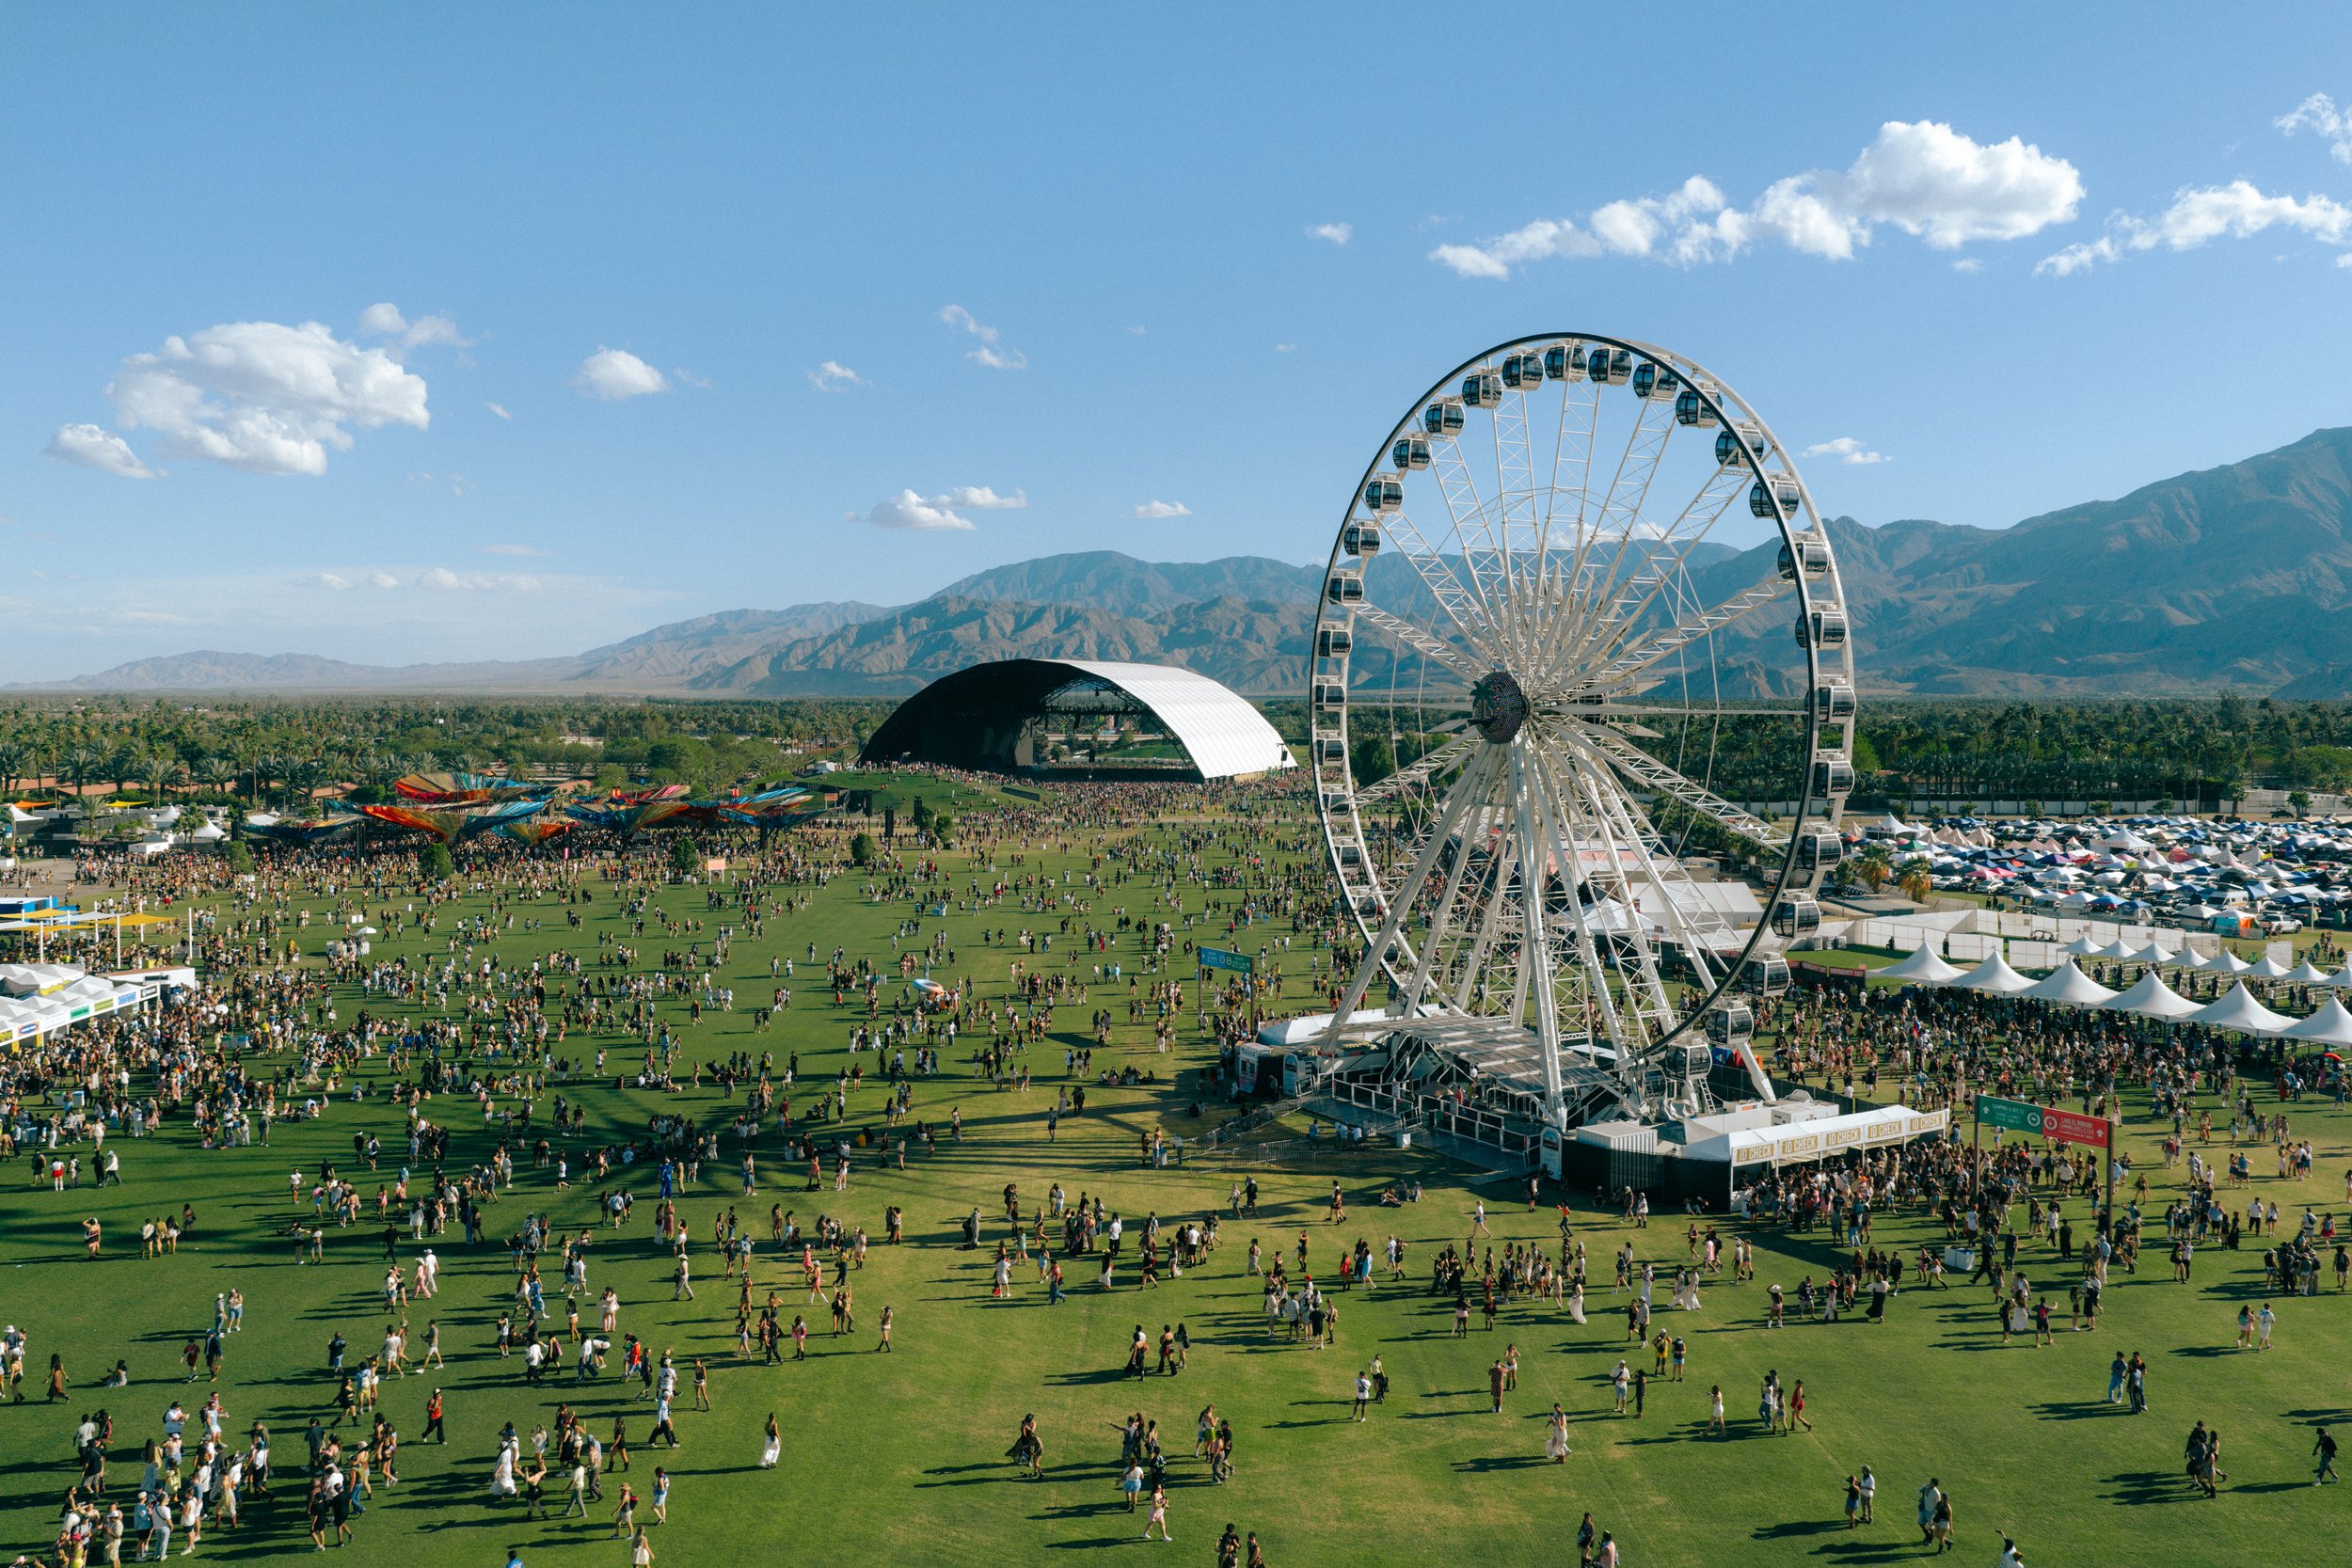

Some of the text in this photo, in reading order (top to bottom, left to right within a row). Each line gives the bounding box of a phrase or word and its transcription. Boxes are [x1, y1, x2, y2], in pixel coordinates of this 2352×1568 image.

[1870, 1121, 1899, 1137] ID CHECK
[1912, 1115, 1941, 1131] ID CHECK
[1785, 1136, 1816, 1153] ID CHECK
[1829, 1129, 1859, 1146] ID CHECK
[1740, 1144, 1772, 1161] ID CHECK
